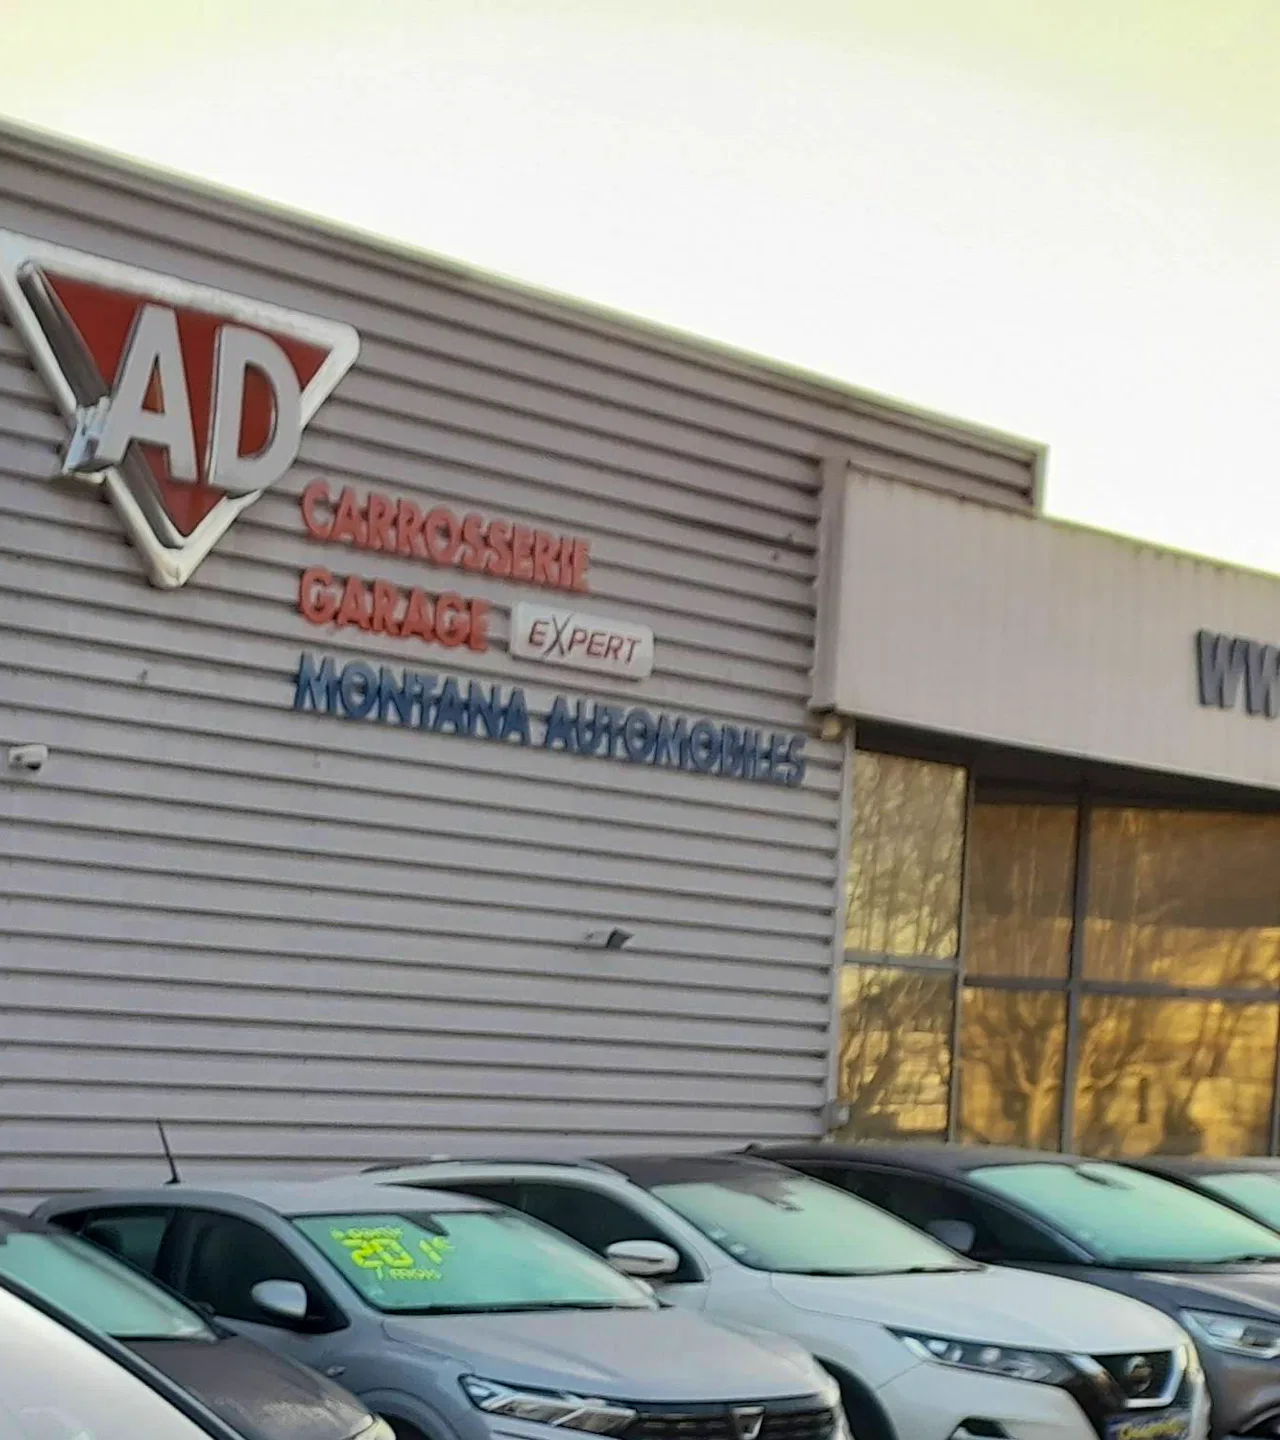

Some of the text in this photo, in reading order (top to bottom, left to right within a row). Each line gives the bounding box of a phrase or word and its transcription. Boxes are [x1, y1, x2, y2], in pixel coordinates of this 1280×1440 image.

[85, 303, 302, 496] AD
[300, 477, 589, 592] CARROSSERIE
[298, 565, 644, 666] GARAGE EXPERT
[294, 651, 807, 787] MONTANA AUTOMOBILES
